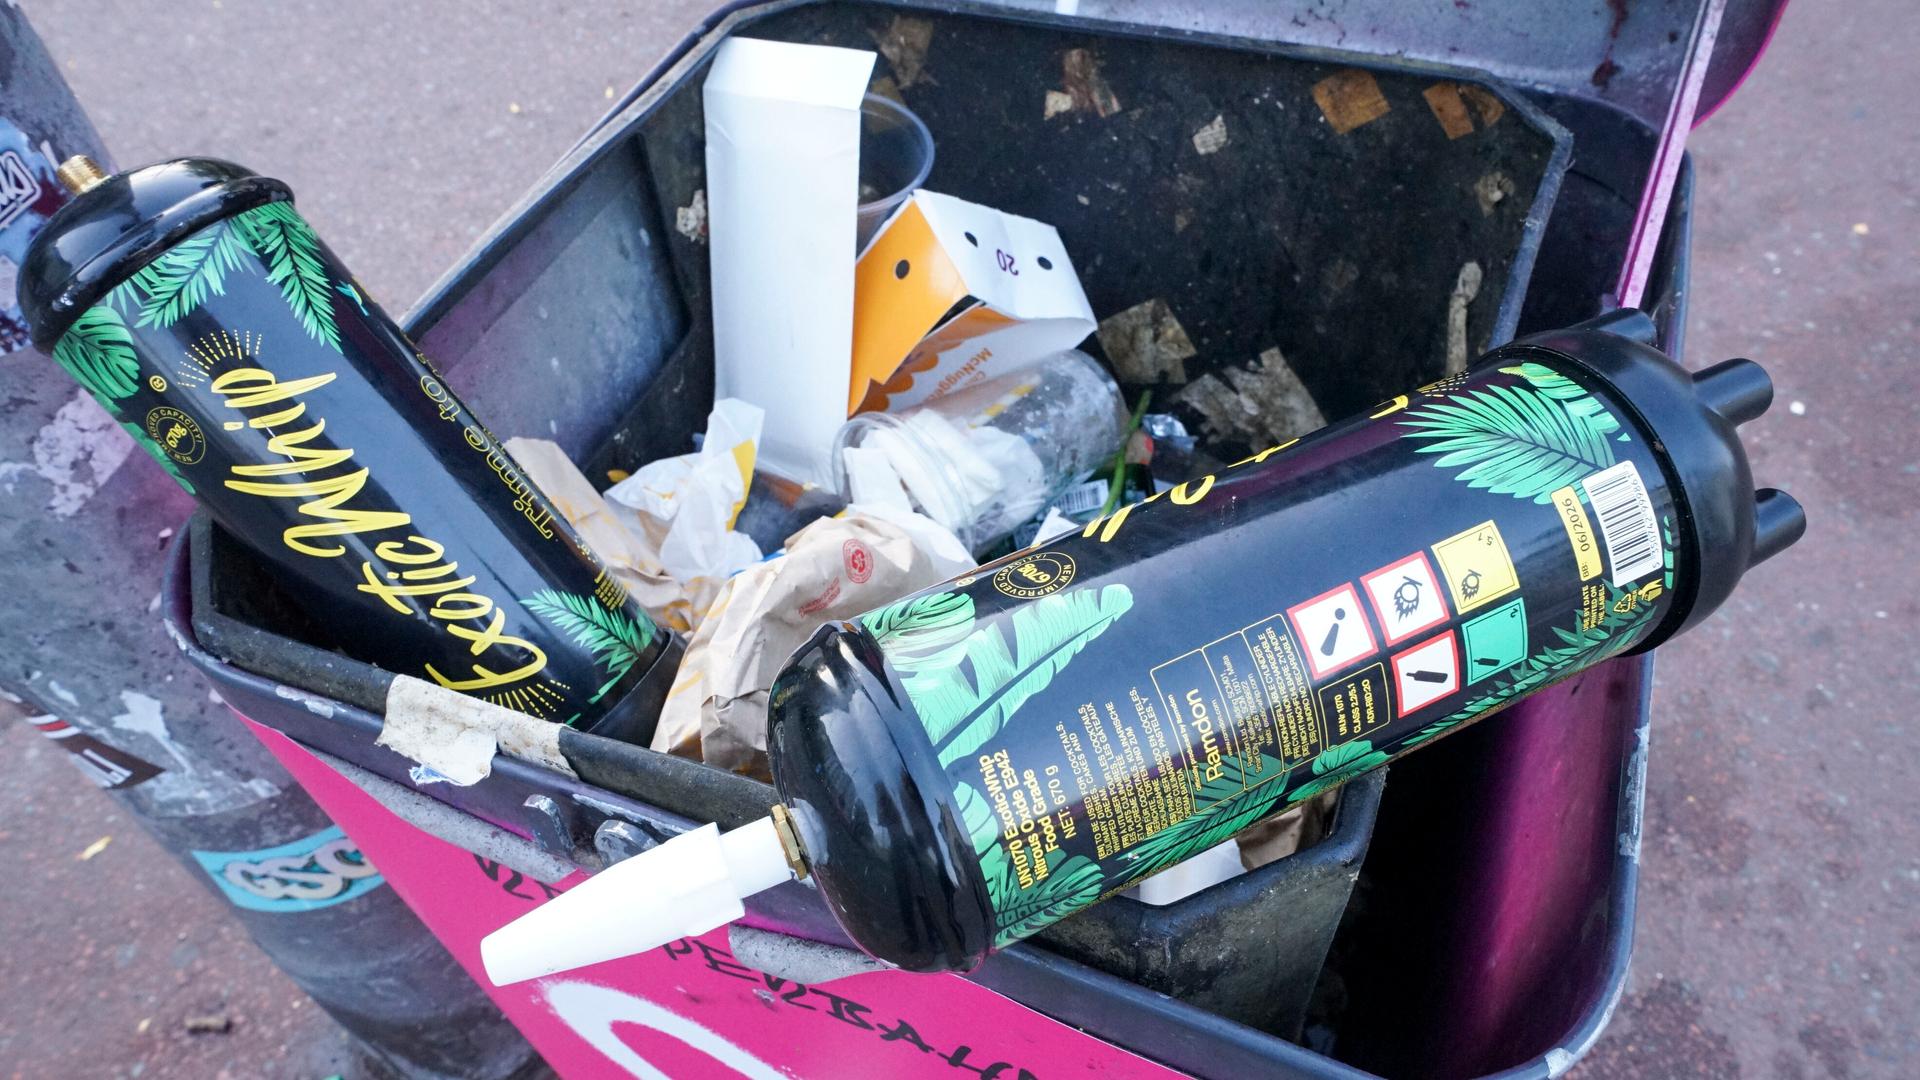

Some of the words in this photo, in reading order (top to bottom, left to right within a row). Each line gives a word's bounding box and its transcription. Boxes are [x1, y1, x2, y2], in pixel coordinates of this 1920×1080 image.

[996, 248, 1020, 277] 20
[420, 375, 461, 422] to
[211, 368, 412, 557] Whip
[464, 425, 558, 539] Time
[1561, 496, 1590, 552] 06/2026
[999, 582, 1059, 597] IMPROVED
[1058, 564, 1073, 583] NEW
[358, 536, 549, 692] Exotic
[1265, 625, 1286, 664] ZYLINDER
[1279, 633, 1303, 686] RECARGABLE
[1252, 643, 1273, 684] CYLINDER
[1257, 631, 1287, 695] RECHARGEABLE
[1280, 694, 1292, 712] NON
[1333, 693, 1344, 713] 1070
[1104, 700, 1134, 762] KULINARISCHE
[1124, 725, 1137, 745] ZUM
[1183, 688, 1225, 781] Ramdon
[1285, 711, 1300, 746] CYLINDER
[1350, 706, 1363, 733] CLASS
[1069, 731, 1082, 752] AND
[1102, 743, 1114, 760] LES
[1132, 745, 1144, 764] UND
[1180, 732, 1196, 765] produced
[993, 748, 1019, 789] E942
[1044, 764, 1058, 776] g
[1077, 752, 1093, 784] CAKES
[1096, 755, 1108, 771] LES
[1151, 747, 1166, 777] USADO
[978, 752, 1018, 839] ExoticWhip
[1021, 767, 1047, 816] Grade
[1047, 777, 1066, 805] 670
[1076, 776, 1089, 795] FOR
[1102, 771, 1117, 795] POUR
[1138, 764, 1154, 797] TORTEN
[1159, 775, 1171, 793] SER
[1175, 767, 1188, 795] BATIDA
[1009, 788, 1035, 833] Oxide
[1083, 795, 1096, 820] USED
[1110, 795, 1126, 829] UTILISER
[1164, 791, 1175, 812] PARA
[1037, 815, 1059, 852] Food
[1056, 805, 1076, 839] NET:
[1090, 820, 1099, 832] BE
[1106, 818, 1121, 852] WHIPPED
[1122, 809, 1134, 832] PLATS
[1093, 832, 1102, 844] TO
[1098, 819, 1113, 856] CULINARY
[1128, 831, 1137, 844] LES
[1009, 838, 1034, 889] UN1070
[1026, 832, 1049, 880] Nitrous
